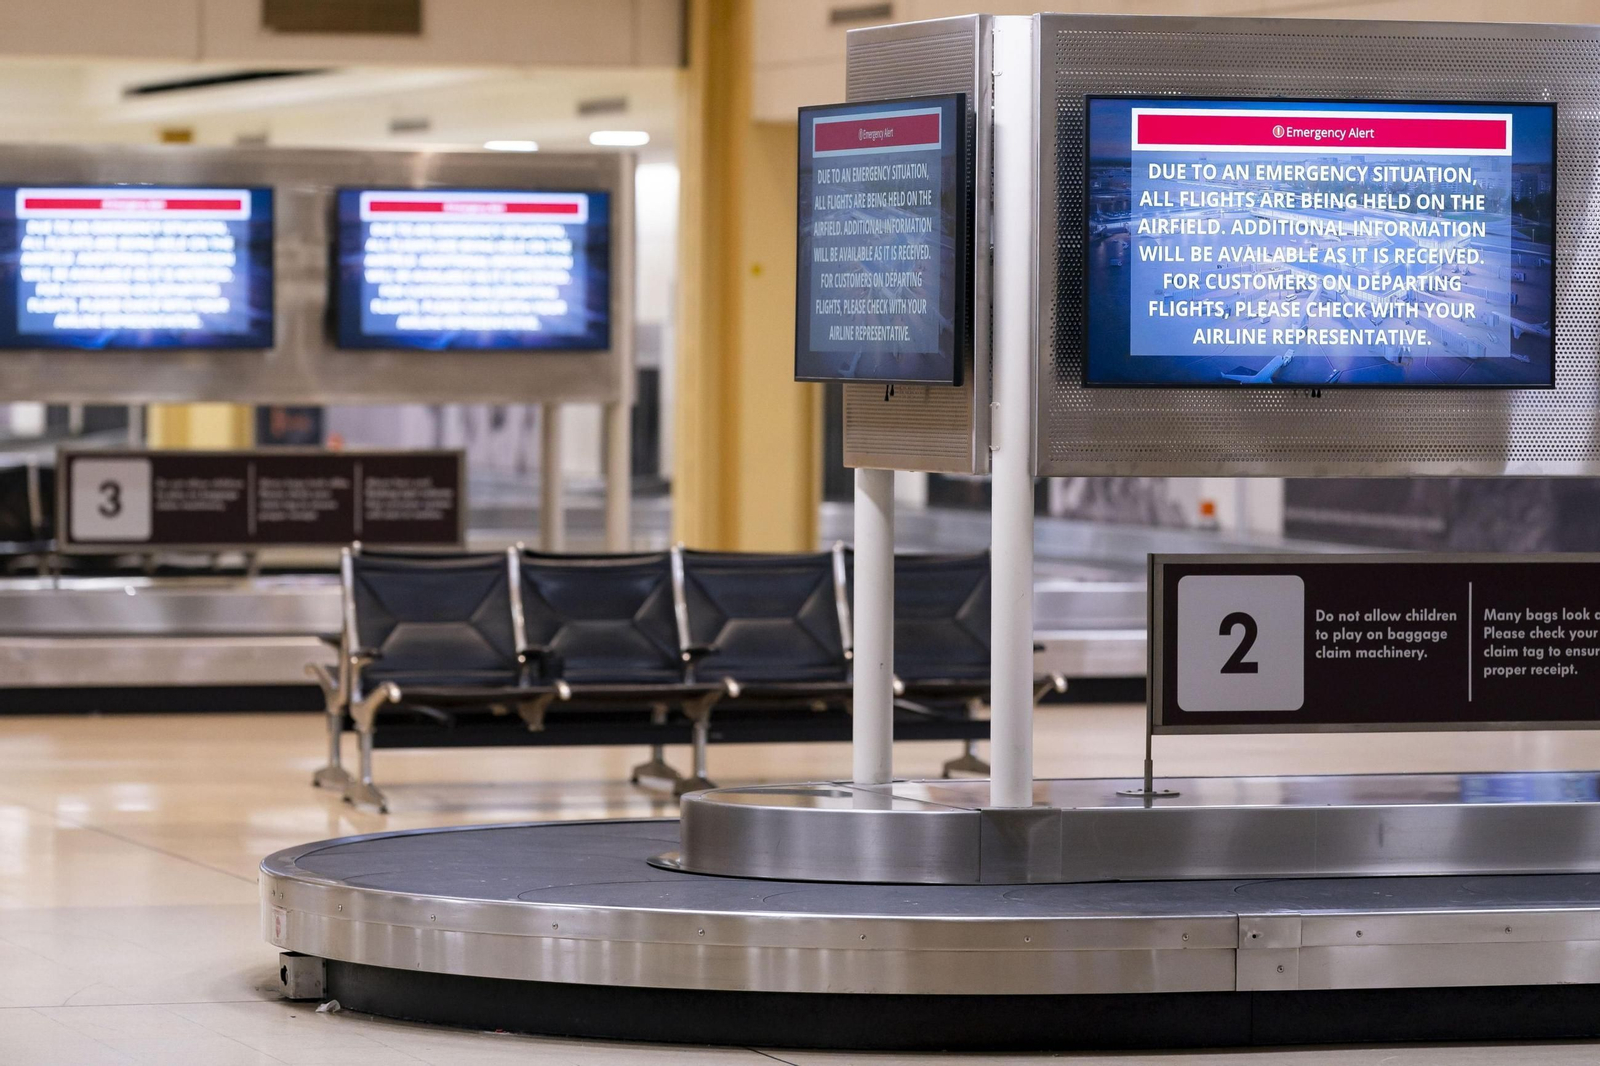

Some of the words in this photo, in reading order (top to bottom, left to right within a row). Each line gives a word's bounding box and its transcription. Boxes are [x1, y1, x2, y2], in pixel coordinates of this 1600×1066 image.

[864, 129, 884, 141] Emergency
[884, 128, 893, 138] Alert
[1286, 127, 1346, 141] Emergency
[1349, 128, 1374, 139] Alert
[818, 170, 830, 184] DUE
[832, 169, 840, 184] TO
[841, 168, 851, 183] AN
[853, 166, 891, 182] EMERGENCY
[892, 163, 929, 181] SITUATION,
[1149, 164, 1186, 180] DUE
[1192, 164, 1217, 180] TO
[1222, 165, 1249, 180] AN
[1256, 165, 1368, 182] EMERGENCY
[1373, 167, 1477, 186] SITUATION,
[815, 196, 826, 210] ALL
[827, 195, 853, 210] FLIGHTS
[854, 194, 866, 209] ARE
[867, 193, 887, 208] BEING
[888, 192, 905, 207] HELD
[907, 191, 918, 206] ON
[919, 190, 932, 205] THE
[1140, 191, 1174, 207] ALL
[1180, 191, 1255, 207] FLIGHTS
[1260, 192, 1295, 208] ARE
[1302, 193, 1357, 209] BEING
[1364, 194, 1411, 209] HELD
[1417, 194, 1444, 210] ON
[1451, 195, 1485, 210] THE
[814, 221, 843, 236] AIRFIELD.
[844, 219, 882, 235] ADDITIONAL
[885, 218, 932, 234] INFORMATION
[1138, 219, 1225, 235] AIRFIELD.
[1231, 219, 1347, 236] ADDITIONAL
[1354, 221, 1486, 237] INFORMATION
[814, 247, 829, 262] WILL
[830, 247, 838, 262] BE
[839, 246, 873, 262] AVAILABLE
[874, 246, 882, 261] AS
[884, 246, 890, 260] IT
[891, 246, 897, 260] IS
[899, 245, 931, 260] RECEIVED.
[1139, 246, 1184, 262] WILL
[1191, 247, 1212, 262] BE
[1218, 247, 1318, 263] AVAILABLE
[1324, 248, 1347, 263] AS
[1352, 248, 1368, 263] IT
[1374, 248, 1389, 263] IS
[1395, 248, 1484, 265] RECEIVED.
[821, 274, 834, 288] FOR
[835, 273, 872, 288] CUSTOMERS
[873, 273, 883, 287] ON
[885, 272, 922, 287] DEPARTING
[1163, 274, 1200, 289] FOR
[1206, 274, 1317, 290] CUSTOMERS
[1323, 275, 1351, 291] ON
[1358, 275, 1461, 291] DEPARTING
[816, 300, 842, 316] FLIGHTS,
[844, 300, 865, 315] PLEASE
[867, 300, 888, 314] CHECK
[890, 299, 906, 314] WITH
[908, 299, 927, 314] YOUR
[1149, 301, 1230, 320] FLIGHTS,
[1236, 302, 1300, 317] PLEASE
[1307, 302, 1367, 318] CHECK
[1371, 302, 1418, 318] WITH
[1424, 303, 1476, 319] YOUR
[829, 326, 854, 341] AIRLINE
[856, 326, 910, 341] REPRESENTATIVE.
[1193, 329, 1267, 344] AIRLINE
[1272, 329, 1431, 345] REPRESENTATIVE.
[97, 480, 122, 519] 3
[1316, 610, 1334, 622] Do
[1339, 611, 1360, 622] not
[1364, 609, 1401, 622] allow
[1406, 608, 1457, 621] children
[1484, 608, 1522, 624] Many
[1526, 608, 1558, 624] bags
[1563, 607, 1590, 620] look
[1316, 629, 1328, 640] to
[1333, 627, 1362, 643] play
[1367, 631, 1383, 640] on
[1388, 627, 1448, 643] baggage
[1484, 626, 1525, 639] Please
[1530, 626, 1565, 638] check
[1569, 630, 1598, 641] your
[1218, 612, 1259, 674] 2
[1316, 646, 1351, 658] claim
[1356, 645, 1428, 661] machinery.
[1484, 644, 1518, 657] claim
[1523, 646, 1544, 660] tag
[1549, 646, 1561, 657] to
[1484, 667, 1526, 678] proper
[1531, 663, 1578, 678] receipt.
